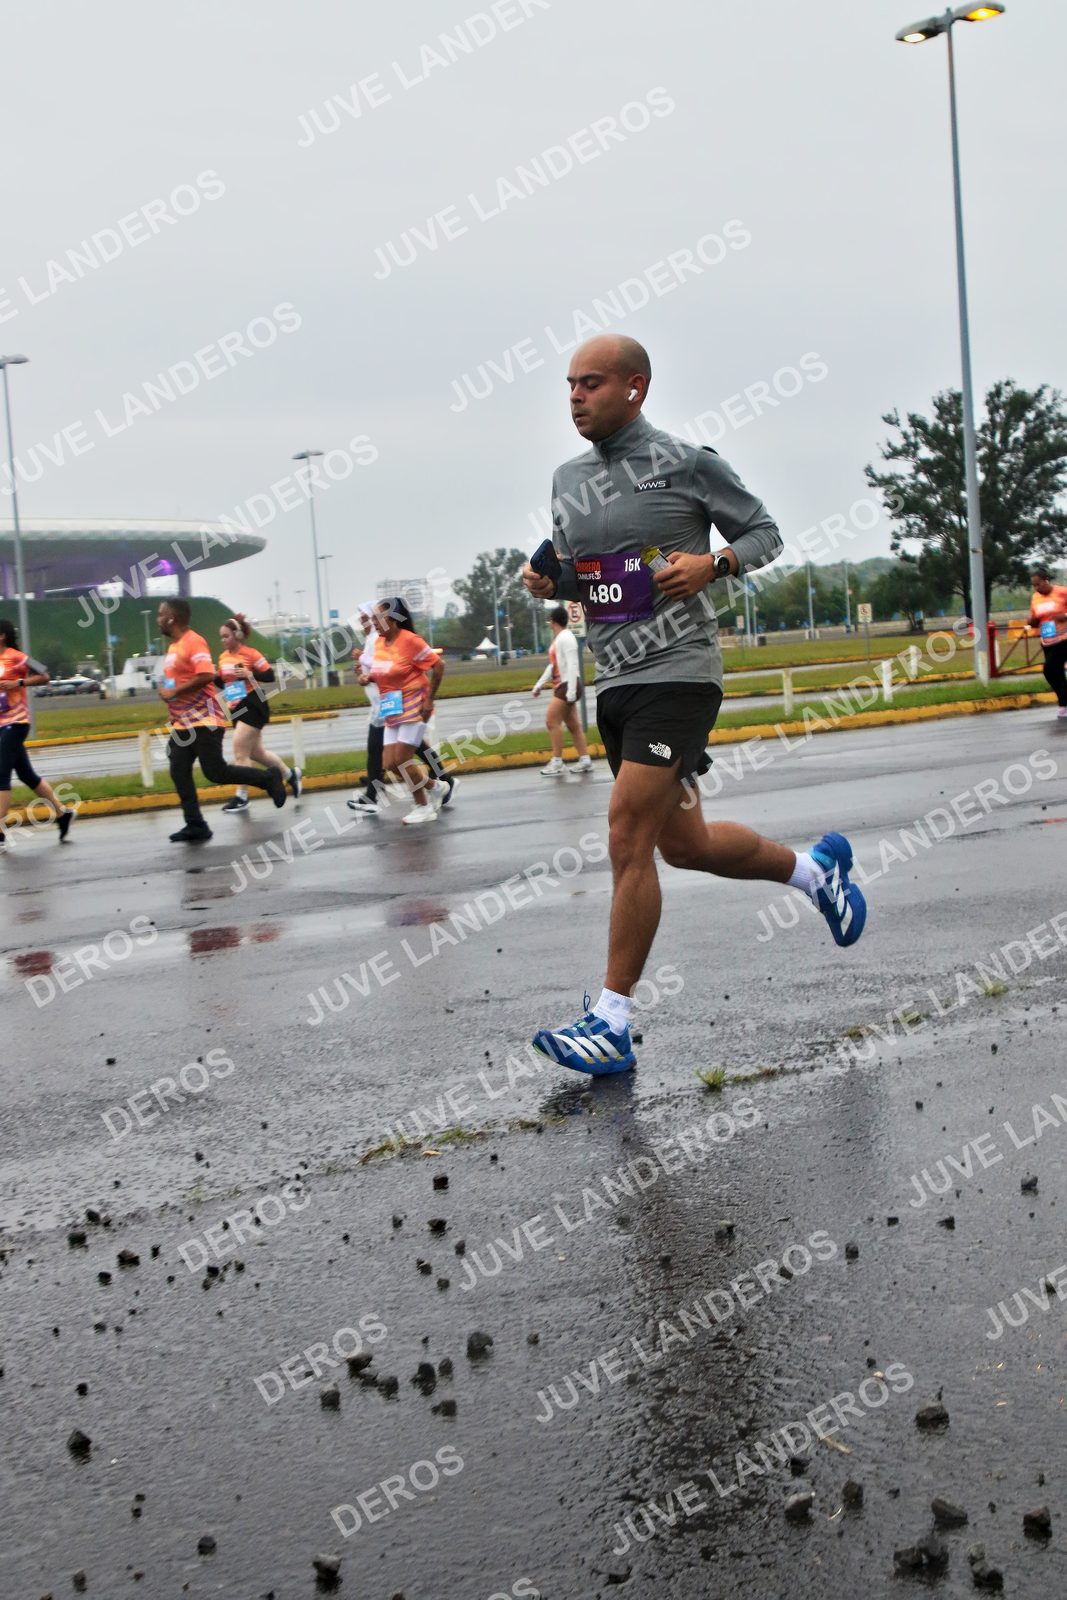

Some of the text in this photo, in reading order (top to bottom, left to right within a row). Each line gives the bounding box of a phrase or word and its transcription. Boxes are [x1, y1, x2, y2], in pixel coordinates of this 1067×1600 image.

[637, 480, 667, 490] WWS
[624, 558, 641, 572] 16K
[589, 583, 623, 604] 480
